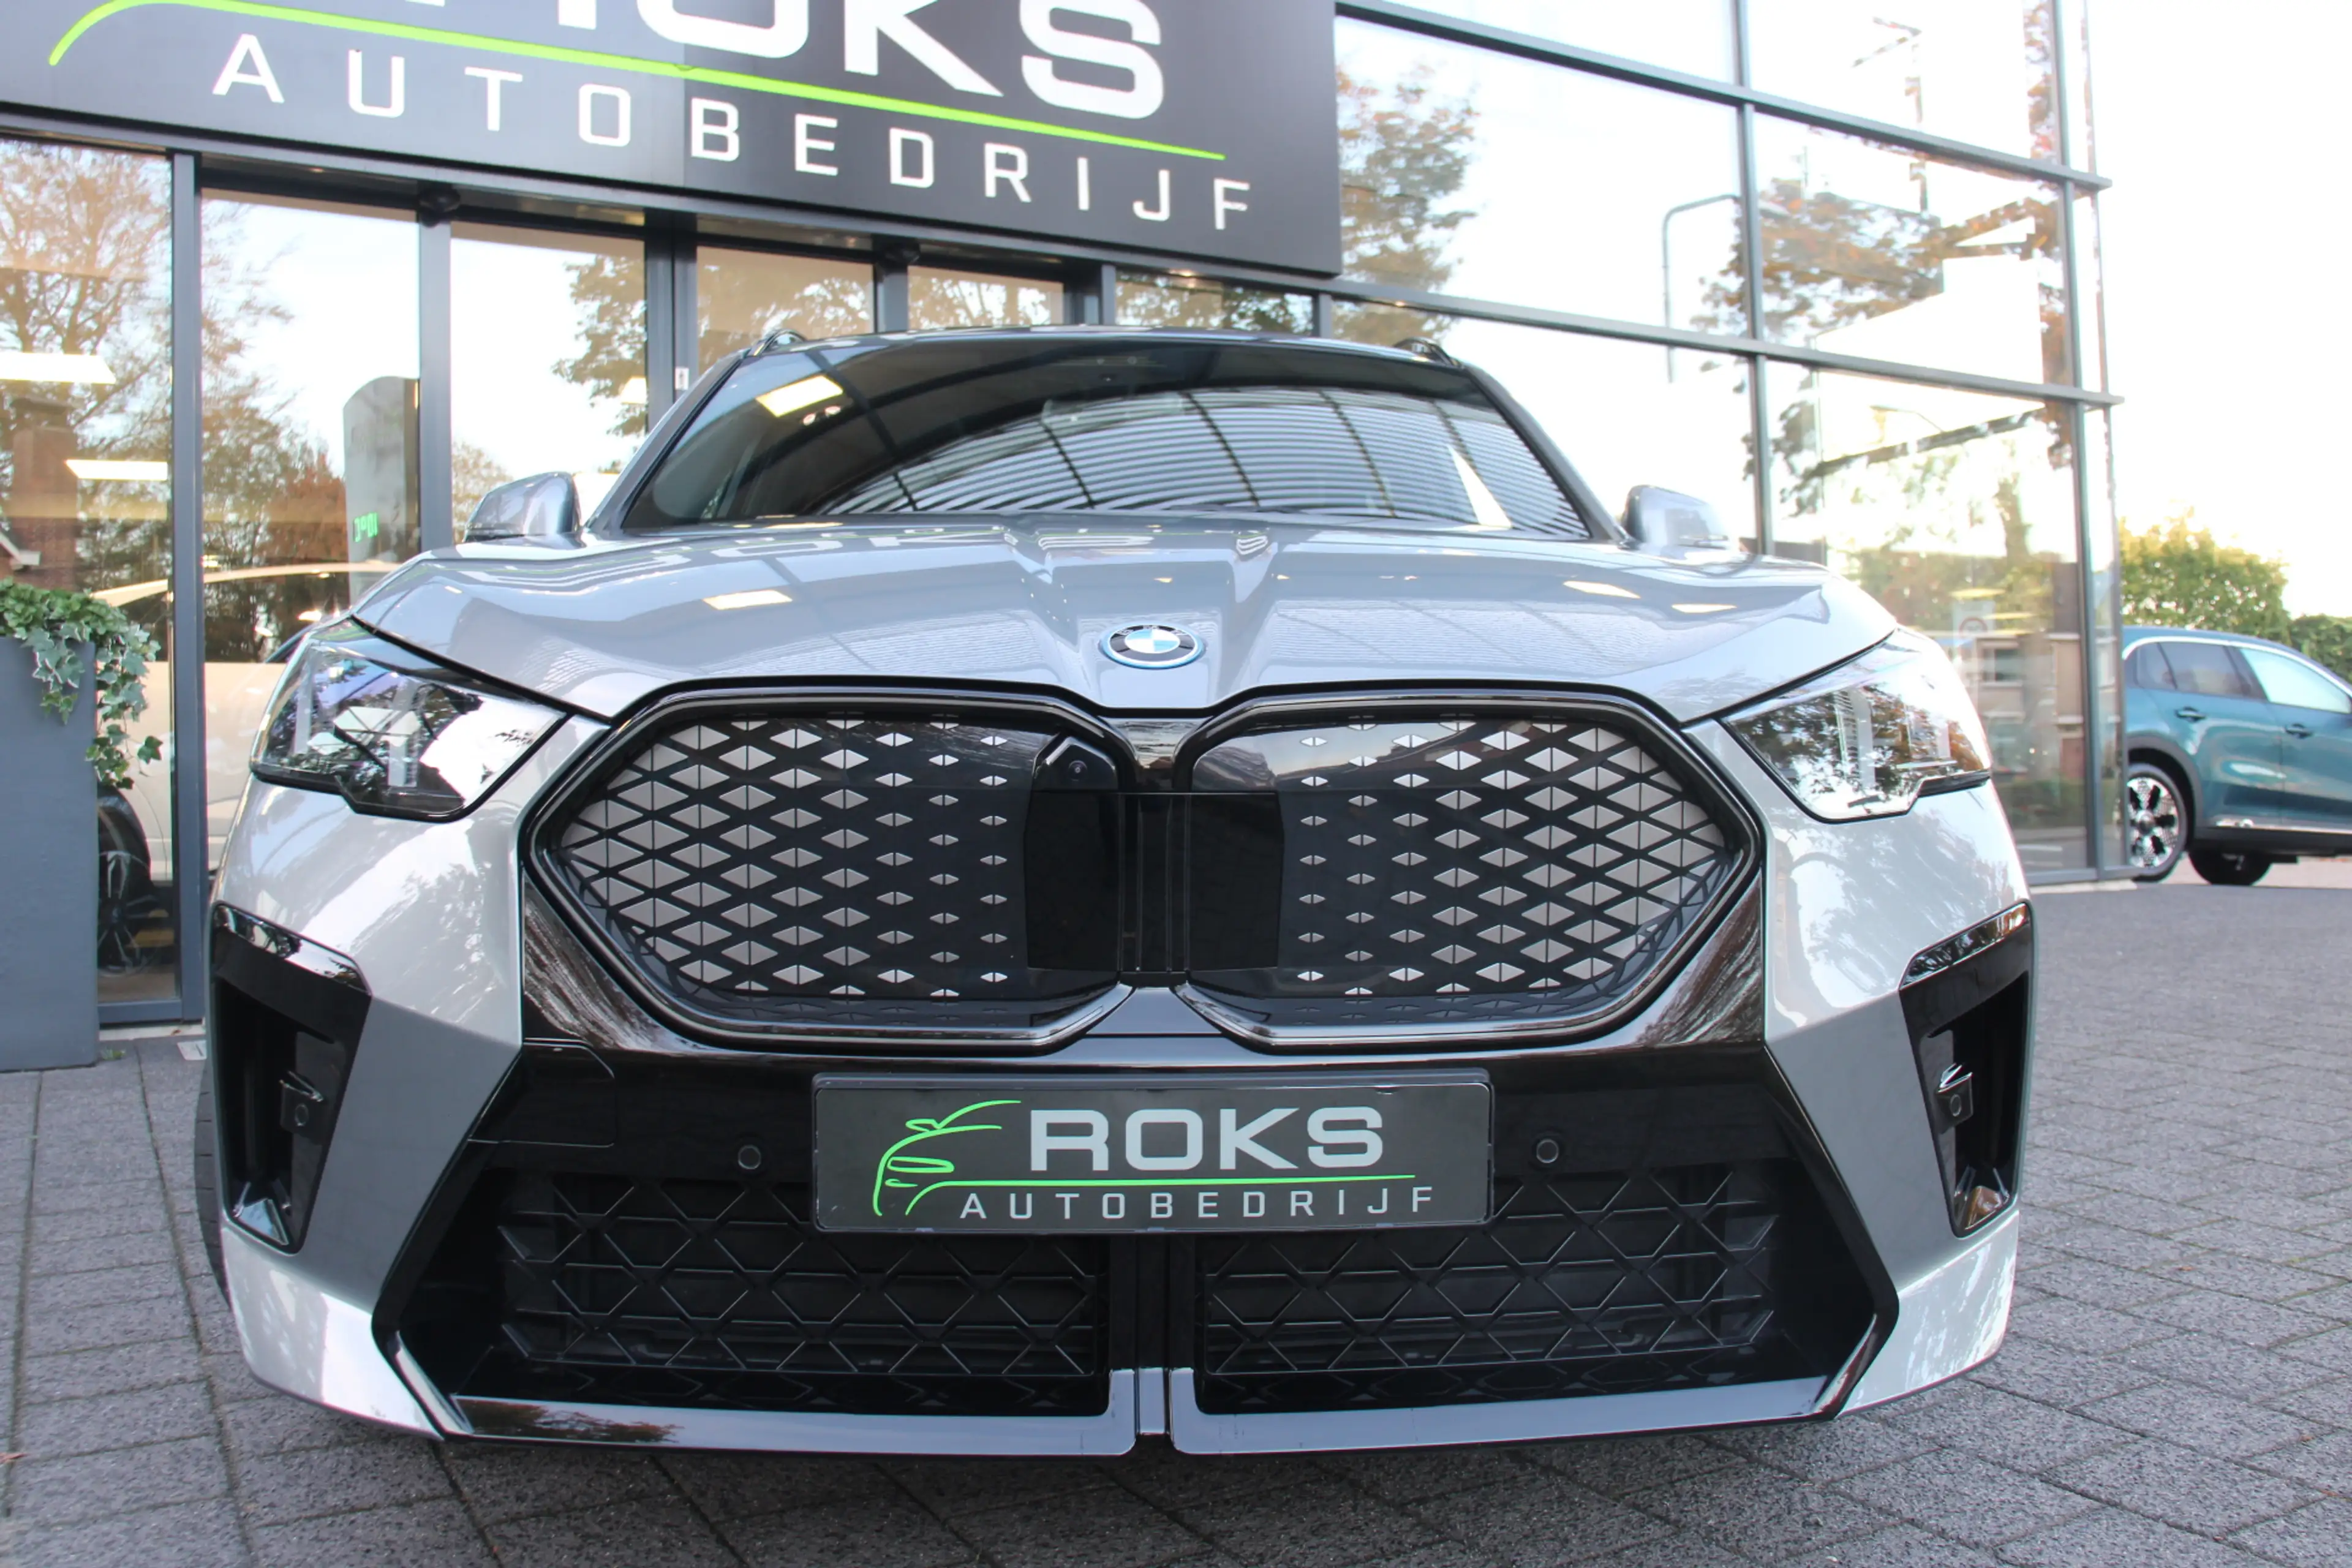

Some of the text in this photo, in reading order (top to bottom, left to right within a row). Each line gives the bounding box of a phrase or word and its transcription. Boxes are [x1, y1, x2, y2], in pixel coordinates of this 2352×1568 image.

[211, 33, 1251, 230] AUTOBEDRIJF
[1030, 1106, 1384, 1172] ROKS
[959, 1186, 1433, 1219] AUTOBEDRIJF
